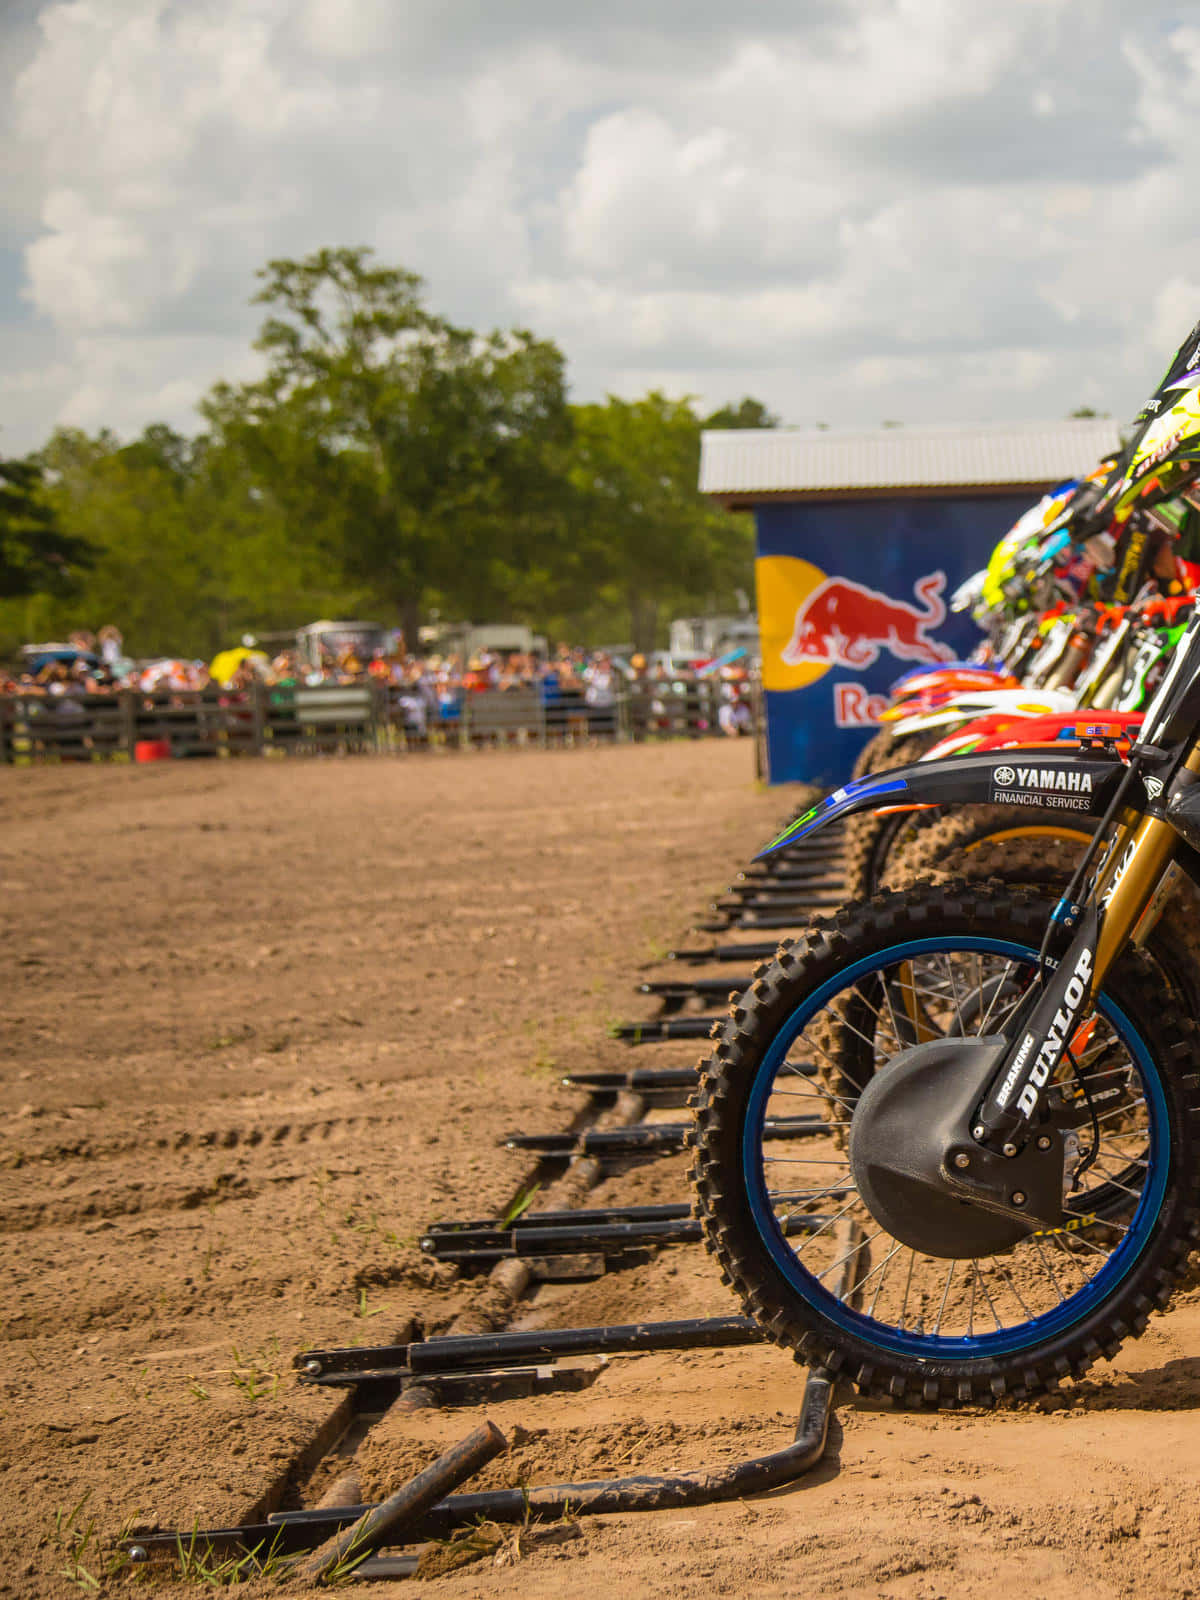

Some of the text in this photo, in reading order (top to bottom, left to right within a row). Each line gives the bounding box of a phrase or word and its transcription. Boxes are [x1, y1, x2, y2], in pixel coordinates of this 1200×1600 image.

[993, 791, 1091, 811] FINANCIAL SERVICES
[1016, 768, 1093, 793] YAMAHA
[1016, 948, 1093, 1120] DUNLOP
[995, 1032, 1035, 1106] BRAKING
